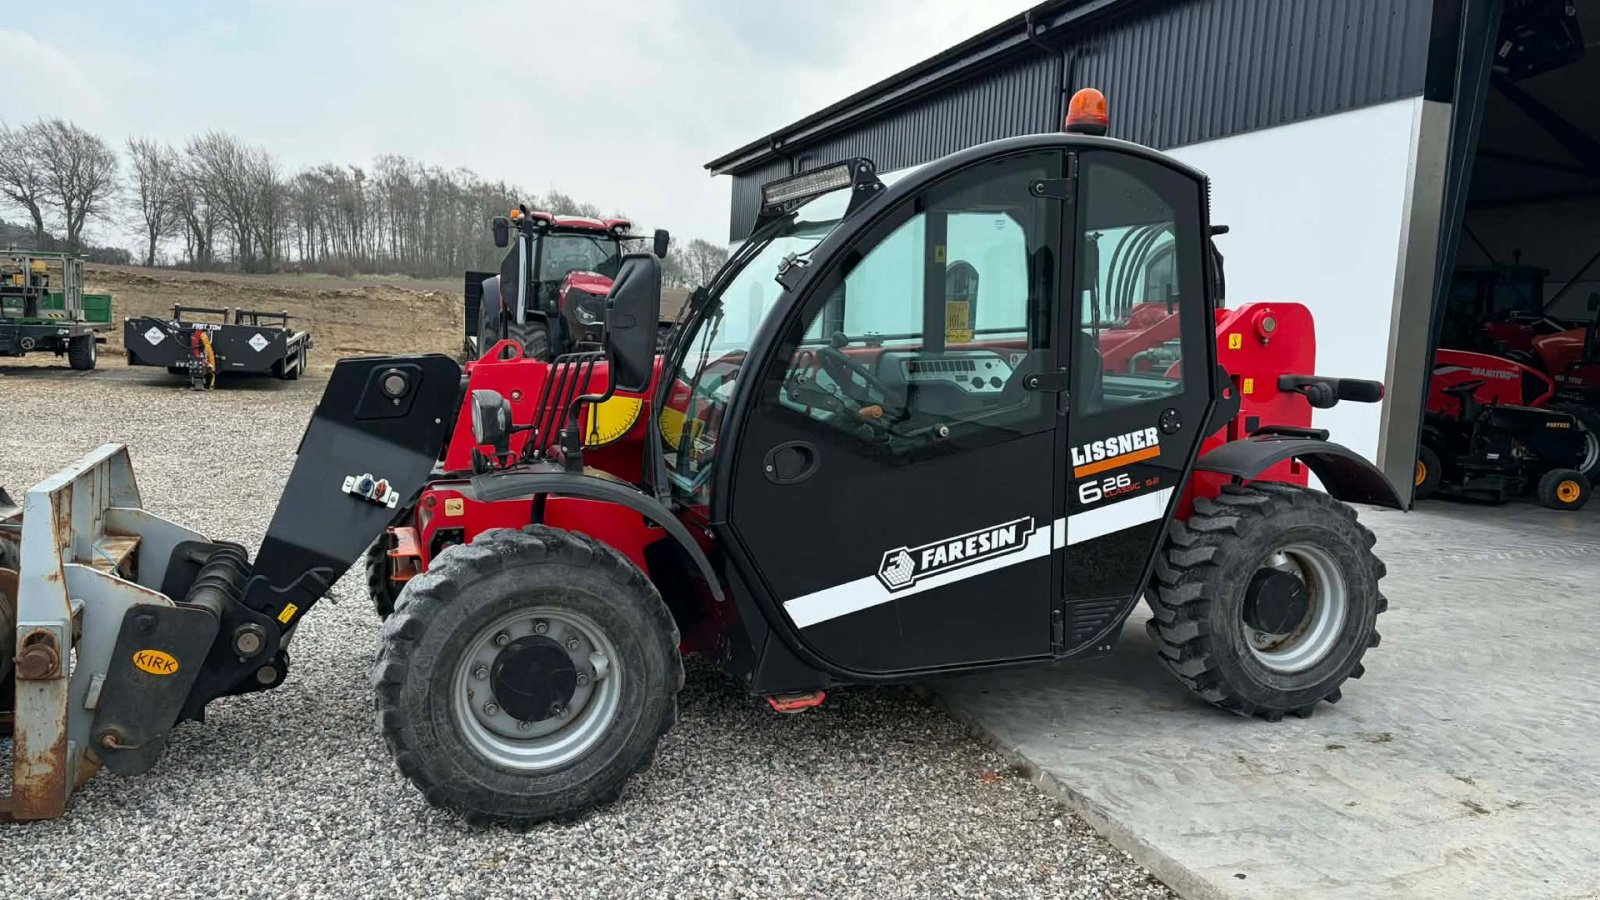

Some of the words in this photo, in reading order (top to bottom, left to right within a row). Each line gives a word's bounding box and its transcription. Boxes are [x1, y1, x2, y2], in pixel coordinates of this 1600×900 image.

[1471, 367, 1512, 380] MANITOU
[1070, 426, 1159, 467] LISSNER
[1104, 481, 1141, 498] CLASSIC
[920, 525, 1017, 571] FARESIN
[136, 652, 176, 672] KIRK
